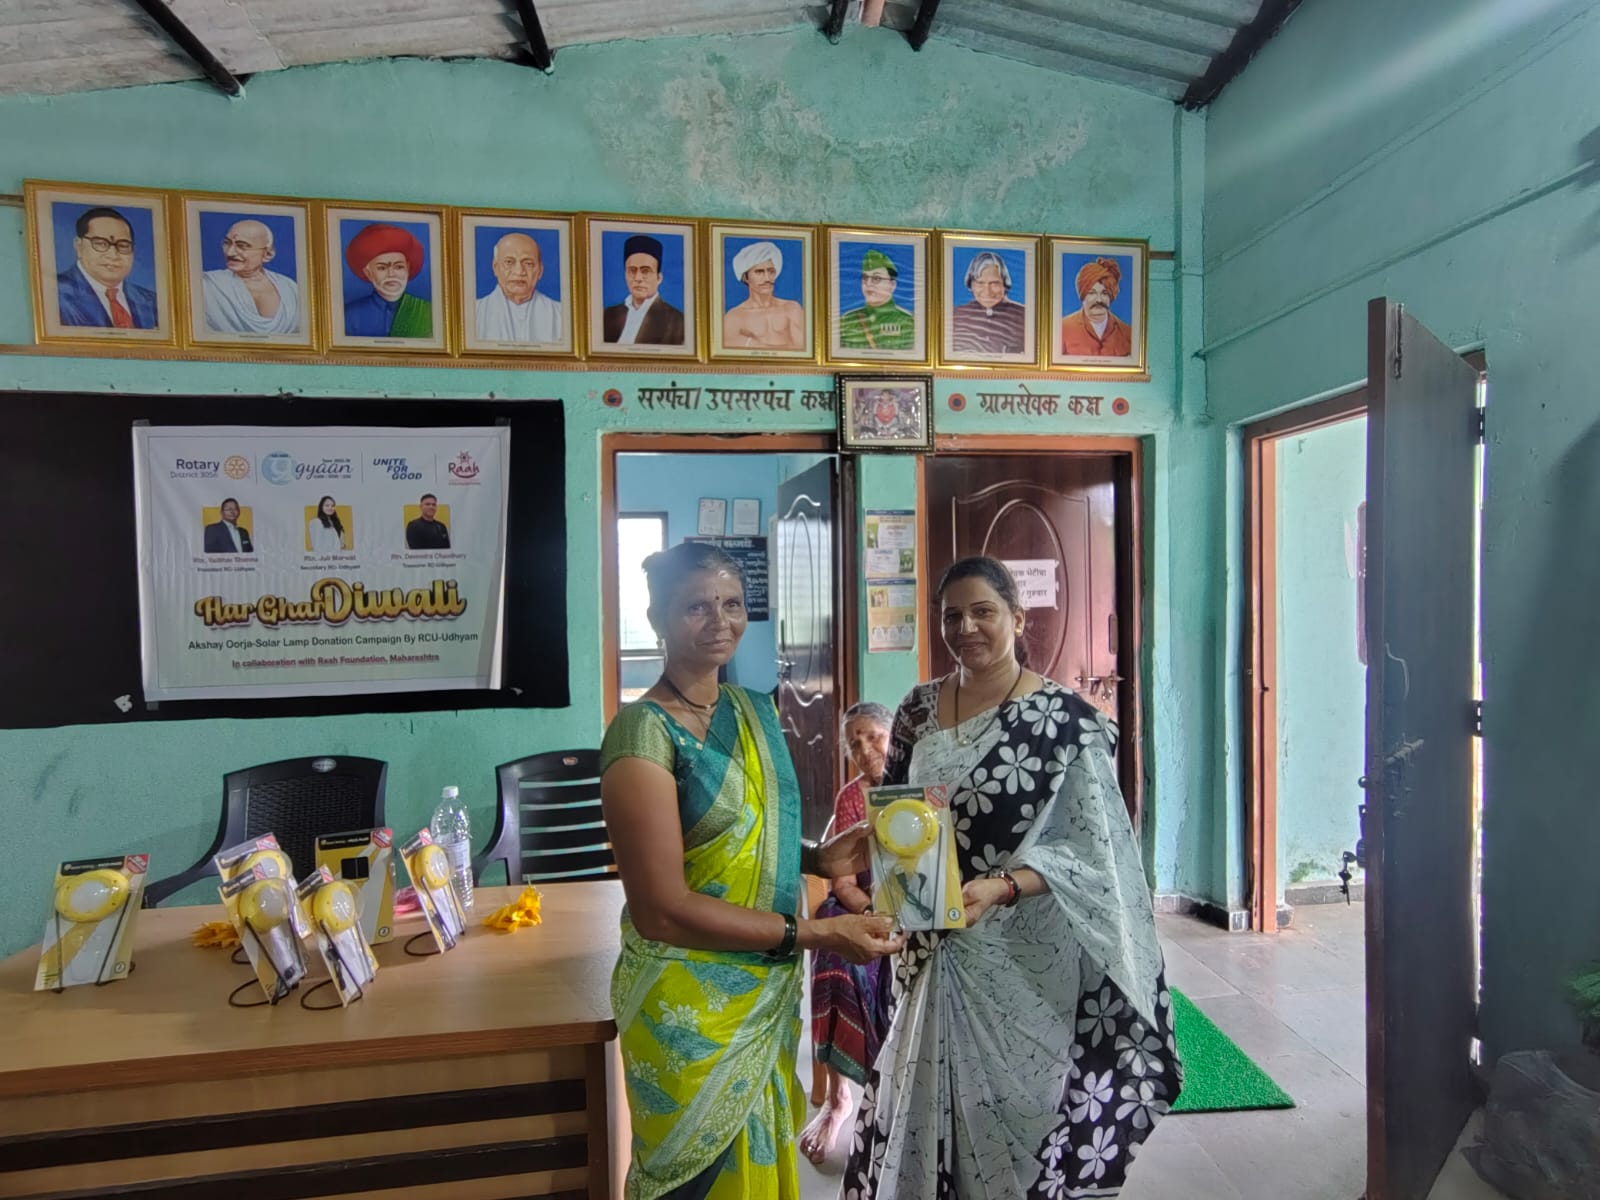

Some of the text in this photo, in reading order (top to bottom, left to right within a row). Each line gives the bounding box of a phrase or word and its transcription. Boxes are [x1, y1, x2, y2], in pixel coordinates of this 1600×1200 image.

[705, 381, 796, 412] उपसरपंच
[975, 383, 1104, 416] ग्रामसेवक कक्ष
[176, 458, 220, 472] Rotary
[373, 458, 407, 466] UNITE
[386, 465, 408, 473] FOR
[448, 462, 480, 473] Raah
[392, 472, 422, 480] GOOD
[195, 595, 255, 627] Har
[311, 577, 468, 624] Diwali
[188, 640, 223, 651] Akshay
[283, 636, 310, 648] Lamp
[312, 635, 353, 646] Donation
[354, 634, 401, 645] Campaign
[404, 633, 416, 645] By
[418, 631, 479, 643] RCU-Udhyam
